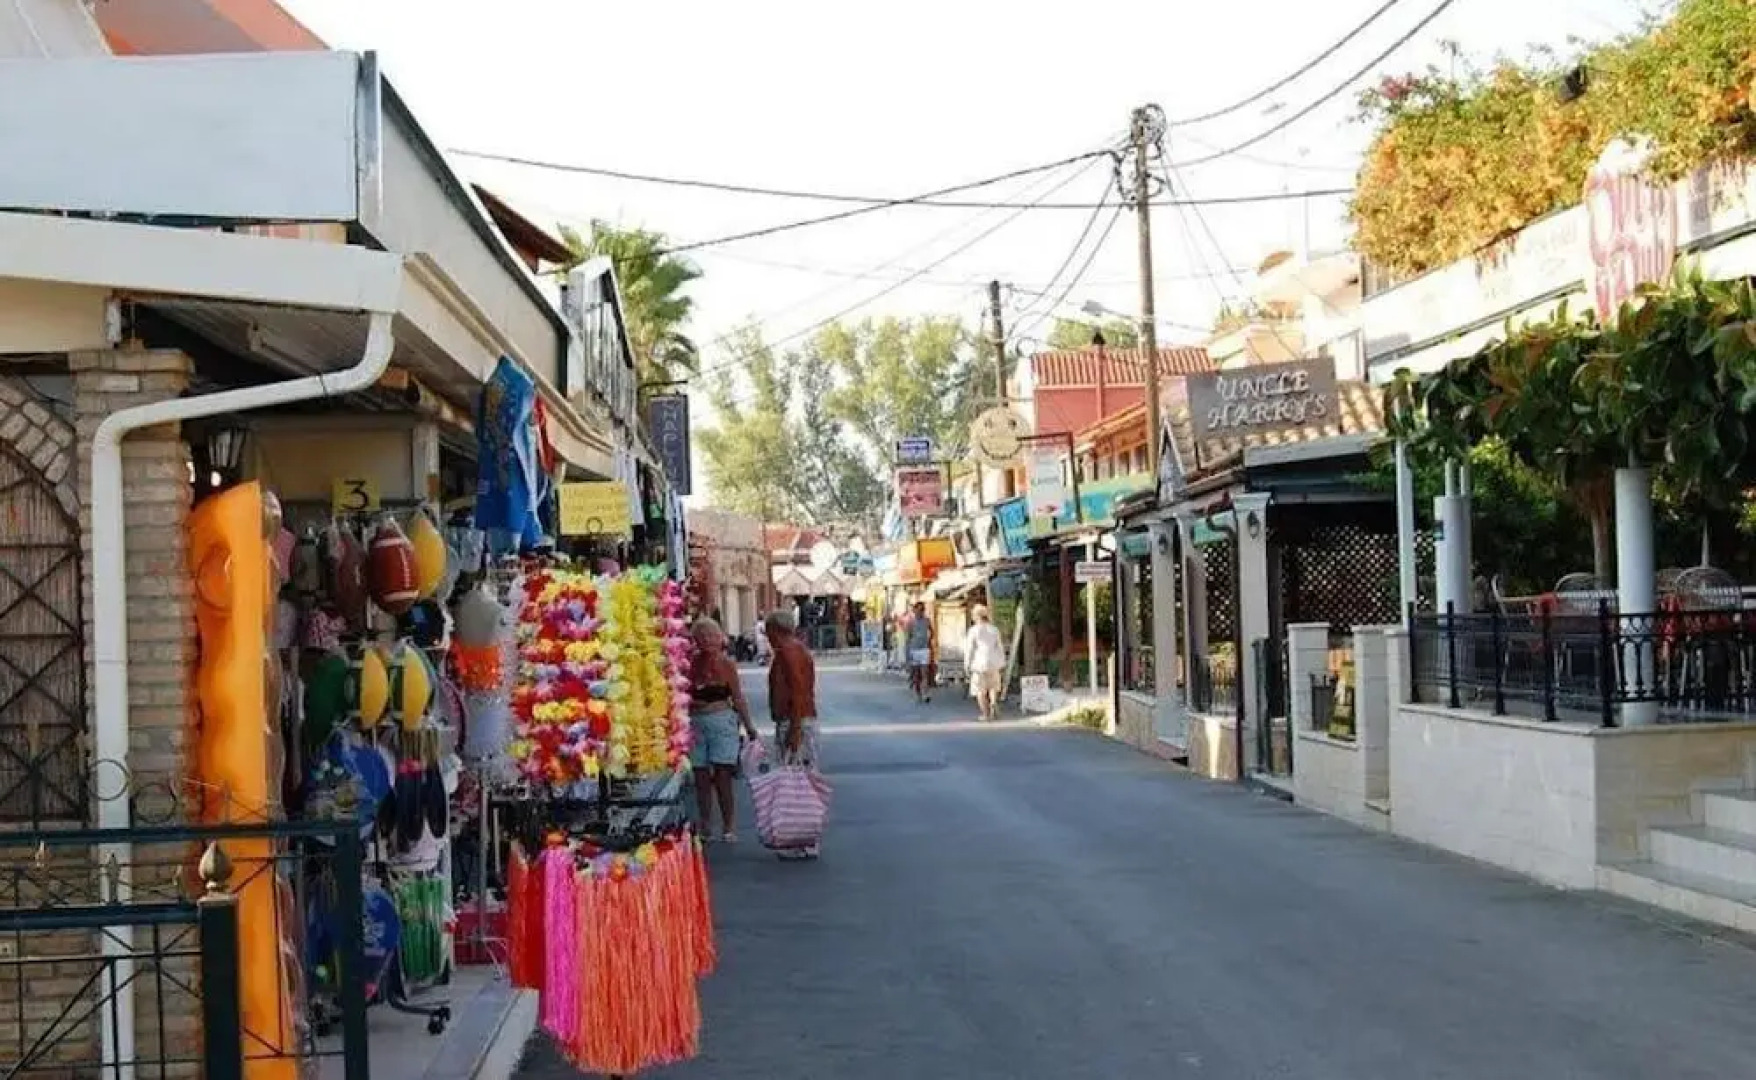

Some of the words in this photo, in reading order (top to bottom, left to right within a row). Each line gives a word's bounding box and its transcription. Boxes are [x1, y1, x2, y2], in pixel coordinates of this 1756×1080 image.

[1216, 370, 1310, 400] UNCLE
[1207, 393, 1327, 429] HARRY'S
[343, 480, 369, 510] 3
